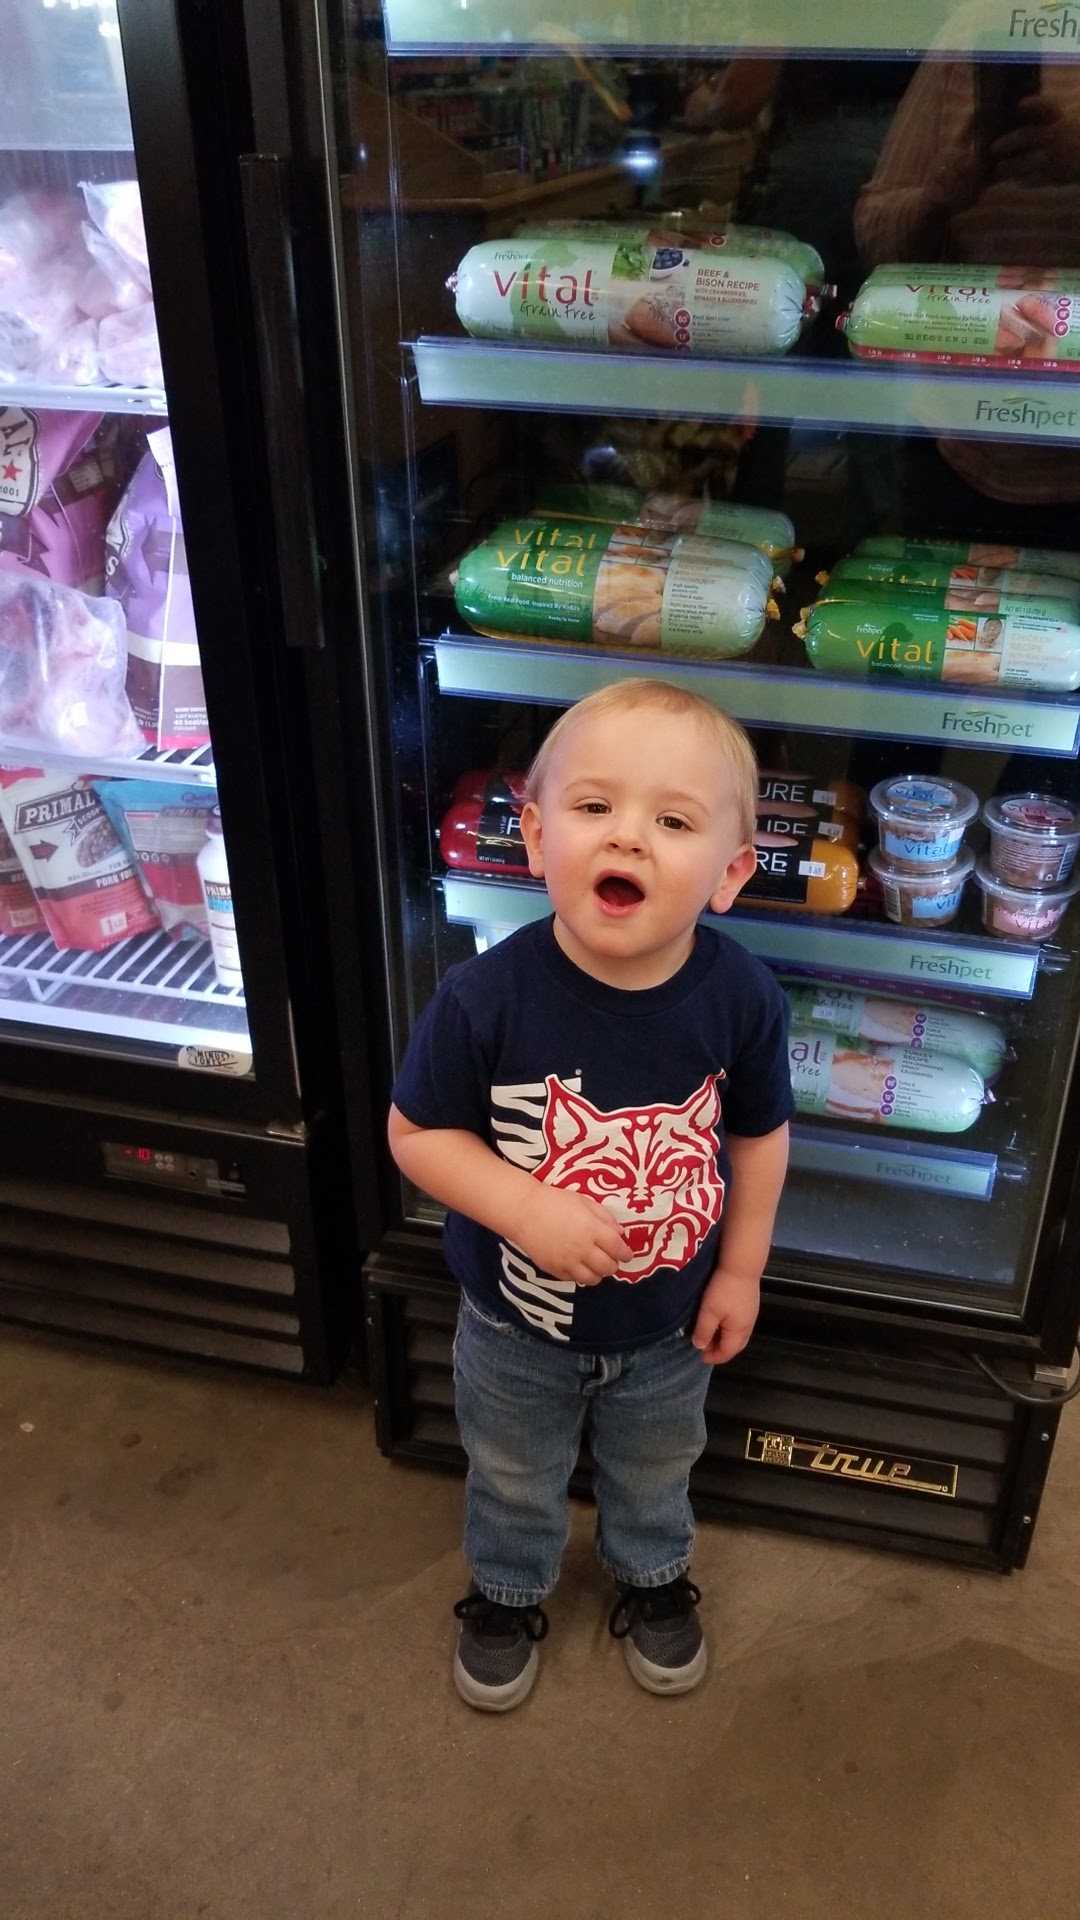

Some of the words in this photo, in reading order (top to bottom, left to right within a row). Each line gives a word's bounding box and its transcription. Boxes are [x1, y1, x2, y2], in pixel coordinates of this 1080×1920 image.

[1009, 9, 1080, 45] Fresh
[696, 277, 725, 288] BISON
[726, 280, 760, 291] RECIPE
[697, 268, 721, 278] BEEF
[723, 271, 730, 279] &
[493, 262, 594, 307] vital
[520, 300, 561, 317] Grain
[564, 302, 596, 321] Free
[975, 399, 1076, 428] Freshpet
[514, 526, 596, 549] vital
[497, 548, 585, 576] vital
[511, 572, 547, 584] balanced
[548, 578, 584, 588] nutrition
[856, 635, 932, 664] vital
[871, 661, 901, 669] balanced
[941, 712, 1034, 738] Freshpet
[758, 782, 807, 803] URE
[24, 791, 96, 825] PRIMAL
[904, 843, 948, 857] vital
[756, 850, 789, 873] RE
[96, 873, 120, 888] PORK
[206, 886, 231, 896] PRIMA
[936, 895, 956, 910] vit
[909, 955, 992, 980] Freshpet
[194, 1057, 222, 1068] FORTY
[197, 1050, 226, 1062] MINUS
[903, 1054, 929, 1063] RECIPE
[796, 1061, 821, 1077] Free
[876, 1161, 952, 1185] Freshpet
[491, 1077, 582, 1341] ARNA
